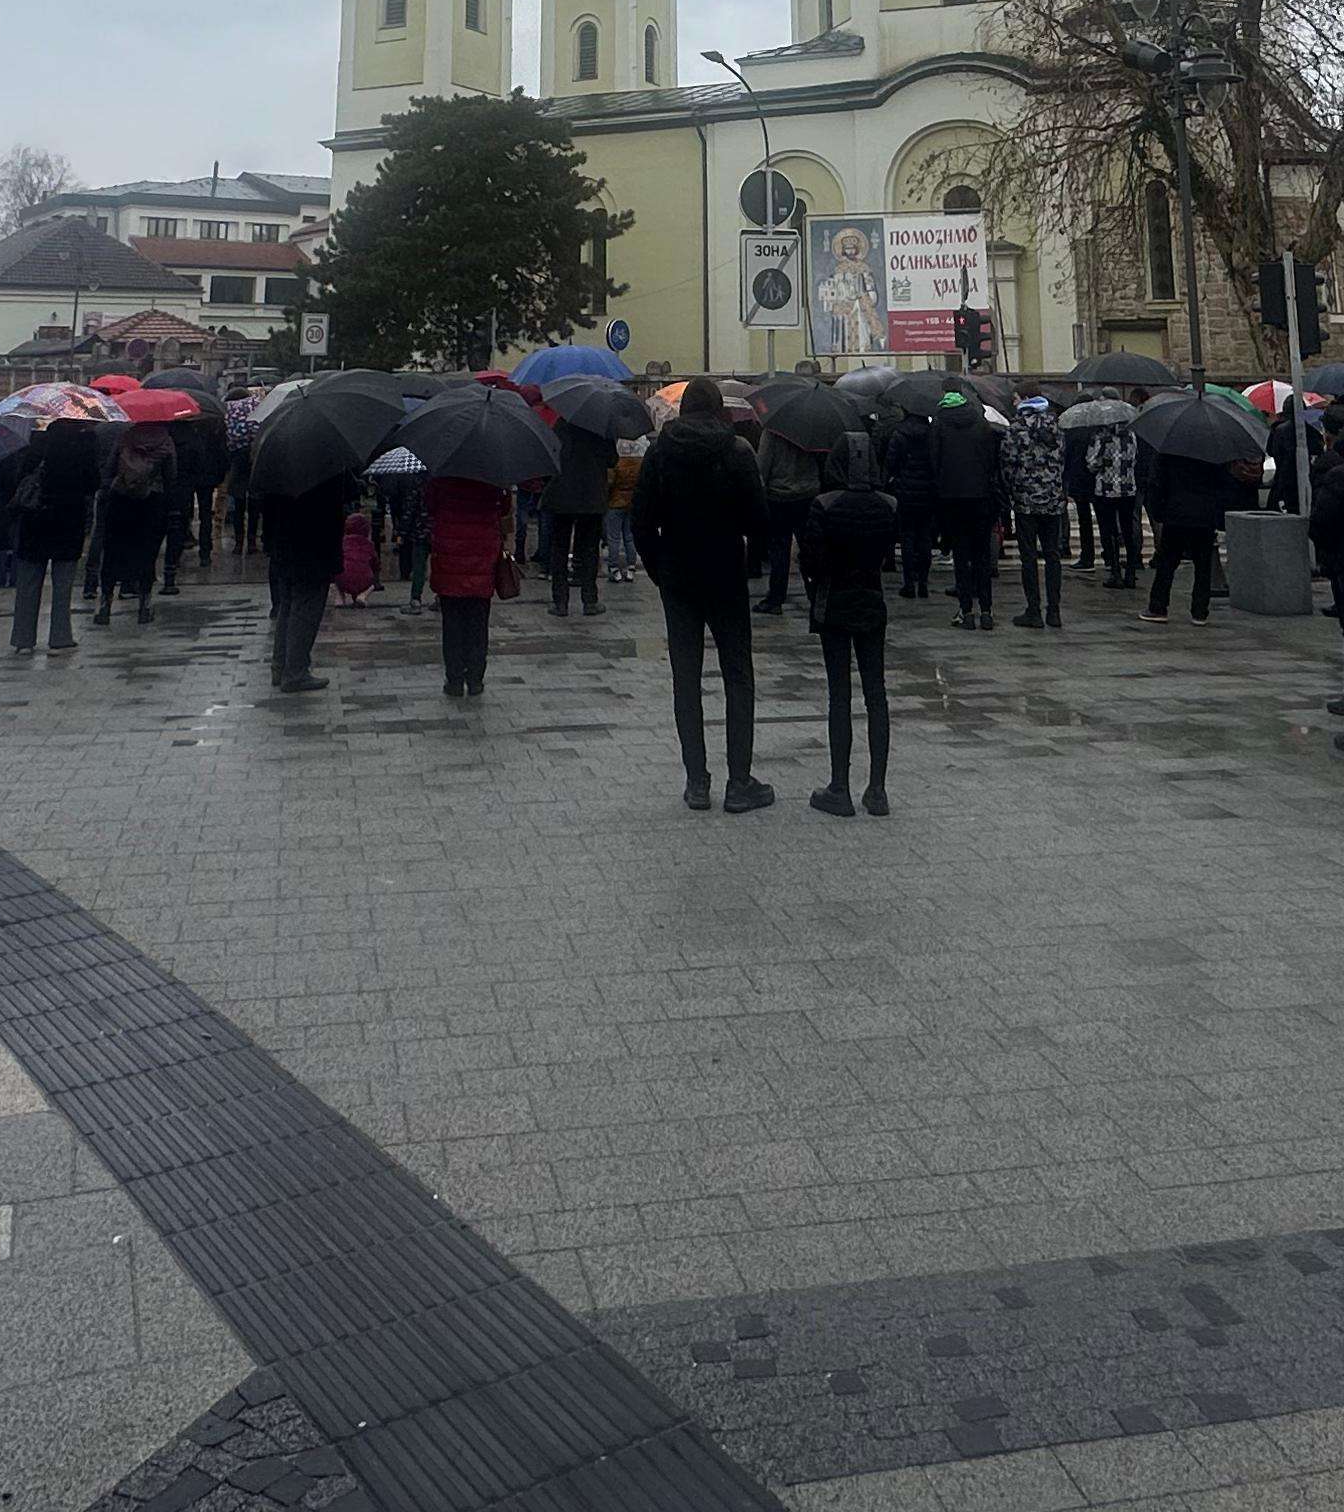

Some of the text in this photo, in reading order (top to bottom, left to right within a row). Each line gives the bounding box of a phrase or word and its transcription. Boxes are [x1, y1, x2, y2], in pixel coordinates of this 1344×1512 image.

[890, 227, 978, 252] ПОМОЗИМО
[754, 244, 789, 257] ЗОНА
[890, 253, 978, 271] ОСЛИКАВАЊЕ
[932, 278, 979, 301] ХРАА
[308, 329, 321, 339] 30
